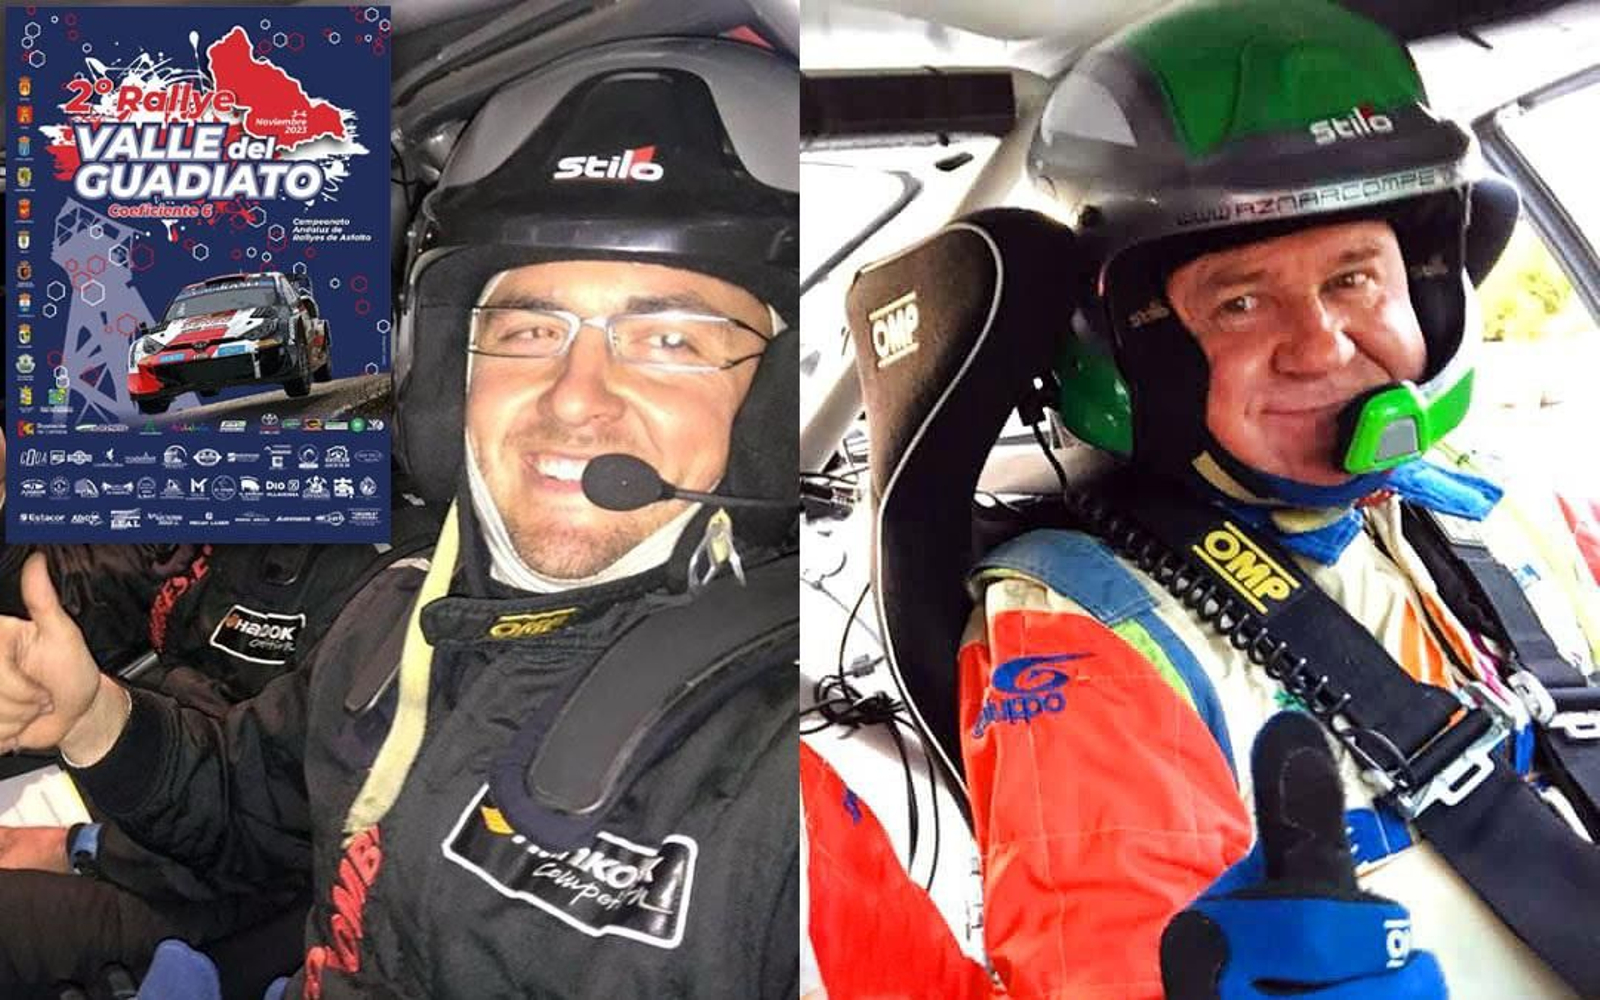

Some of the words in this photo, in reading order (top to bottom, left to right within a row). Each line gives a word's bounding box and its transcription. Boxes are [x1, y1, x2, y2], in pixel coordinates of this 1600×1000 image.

[116, 82, 237, 120] Rallye
[256, 118, 308, 126] Noviembre
[284, 126, 308, 134] 2023
[75, 124, 228, 160] VALLE
[227, 136, 276, 160] del
[76, 163, 322, 199] GUADIATO
[107, 203, 199, 219] Coeficiente
[200, 204, 213, 218] 6
[292, 217, 350, 227] Campeonato
[292, 226, 329, 234] Andaluz
[292, 234, 325, 243] Rallyes
[339, 233, 372, 242] Asfalto
[872, 302, 920, 359] OMP
[1204, 529, 1291, 601] OMP
